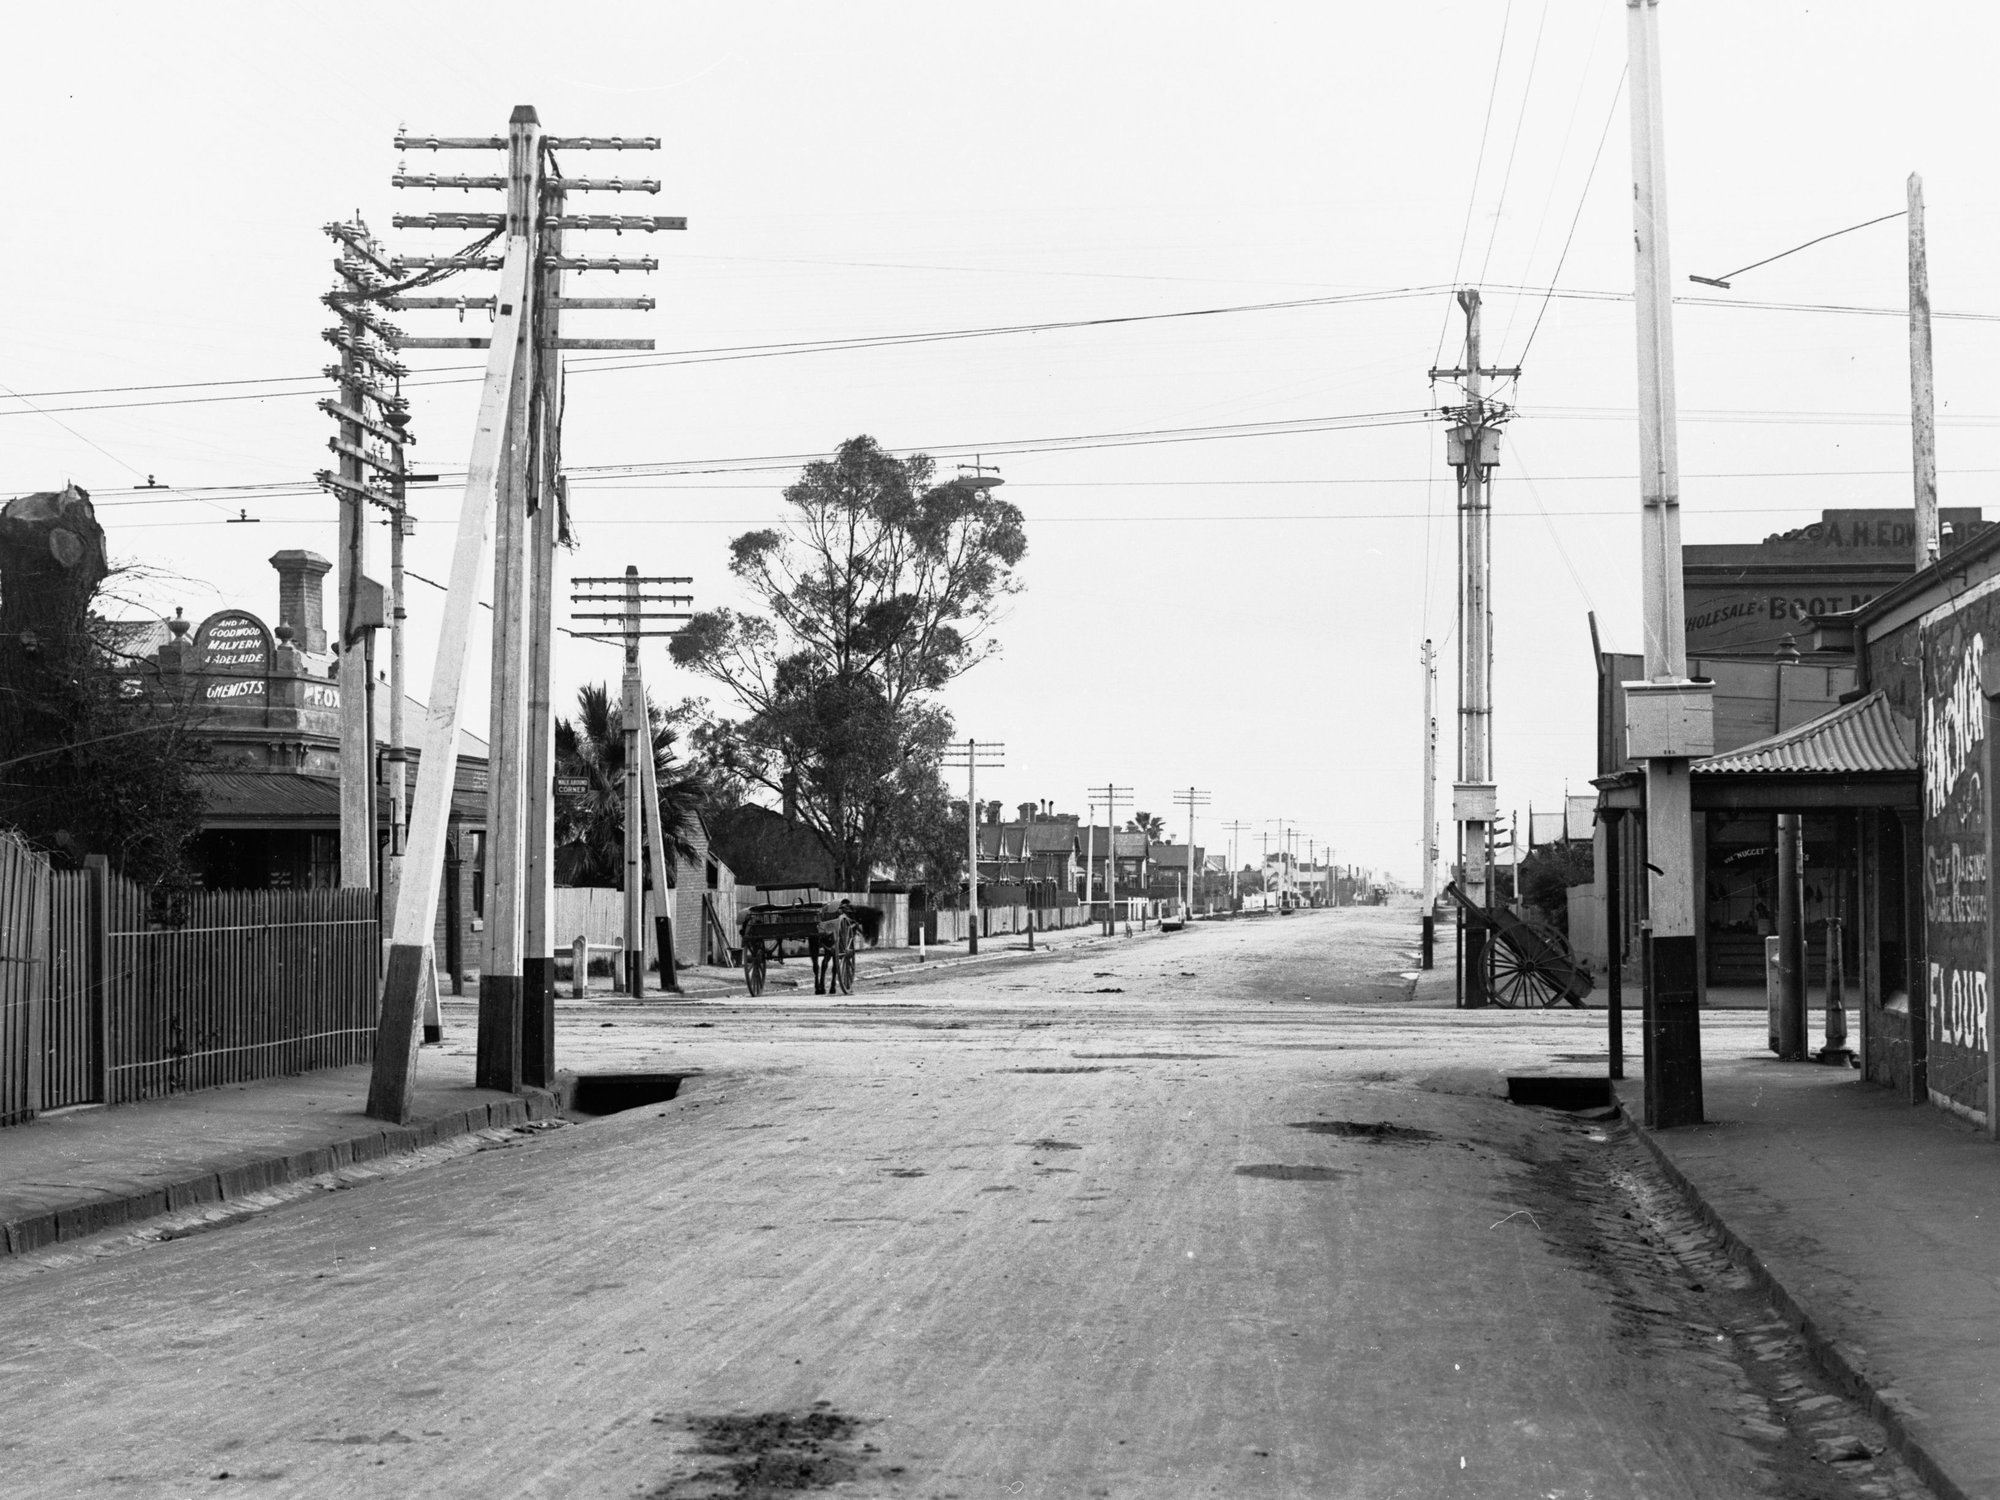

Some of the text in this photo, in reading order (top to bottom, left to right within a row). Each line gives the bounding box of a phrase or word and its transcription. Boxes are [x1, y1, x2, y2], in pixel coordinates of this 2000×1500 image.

[1685, 602, 1757, 633] HOLESALE
[1769, 596, 1843, 620] BOOT
[207, 639, 262, 651] MALVERN
[209, 627, 260, 638] GOODWOOD
[206, 681, 266, 699] CHEMISTS.
[1926, 632, 1985, 821] ANCHOR
[1930, 962, 1989, 1052] FLOUR
